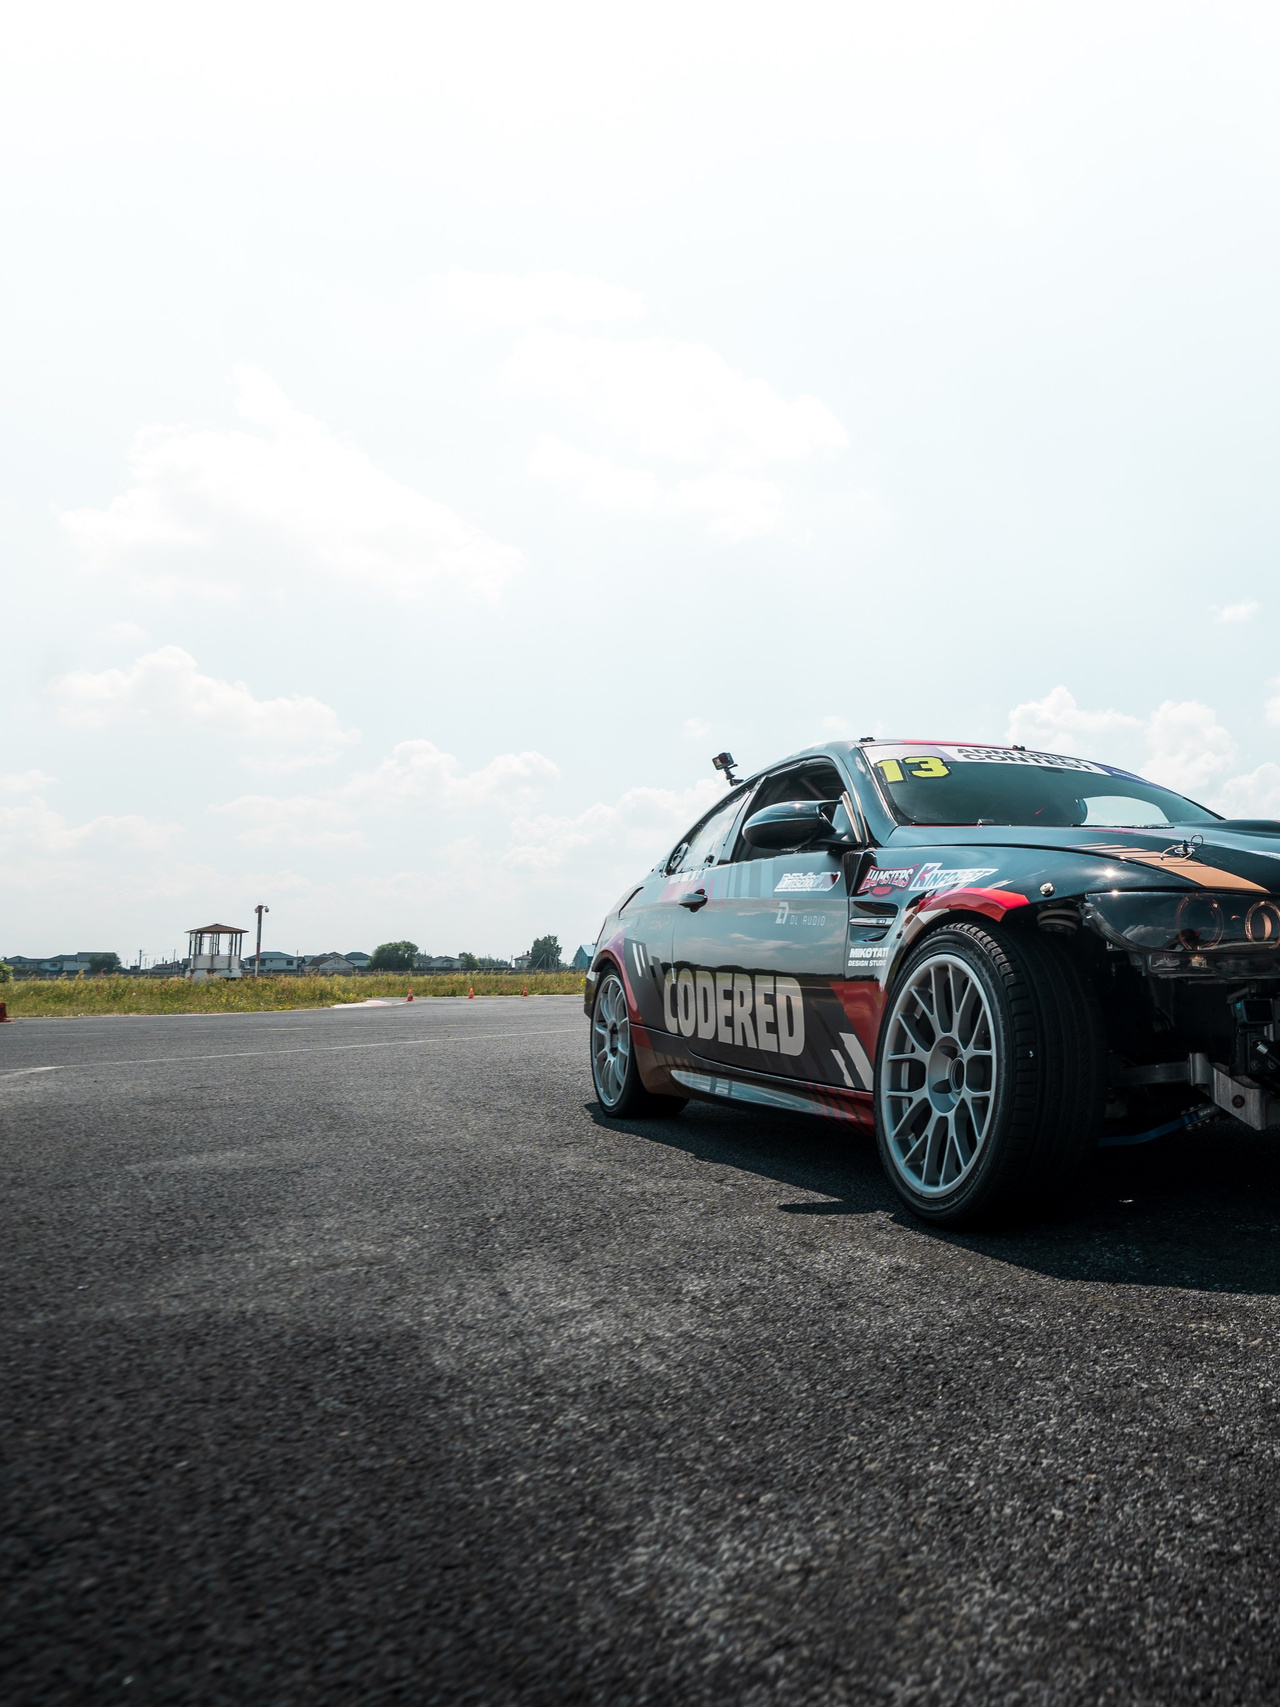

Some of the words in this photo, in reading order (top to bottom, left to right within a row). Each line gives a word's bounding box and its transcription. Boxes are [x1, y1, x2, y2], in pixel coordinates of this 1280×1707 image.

[874, 756, 952, 784] 13
[963, 754, 1094, 771] CONTEST
[860, 868, 914, 891] HAMSTERS
[802, 915, 826, 926] AUDIO
[663, 967, 806, 1057] CODERED
